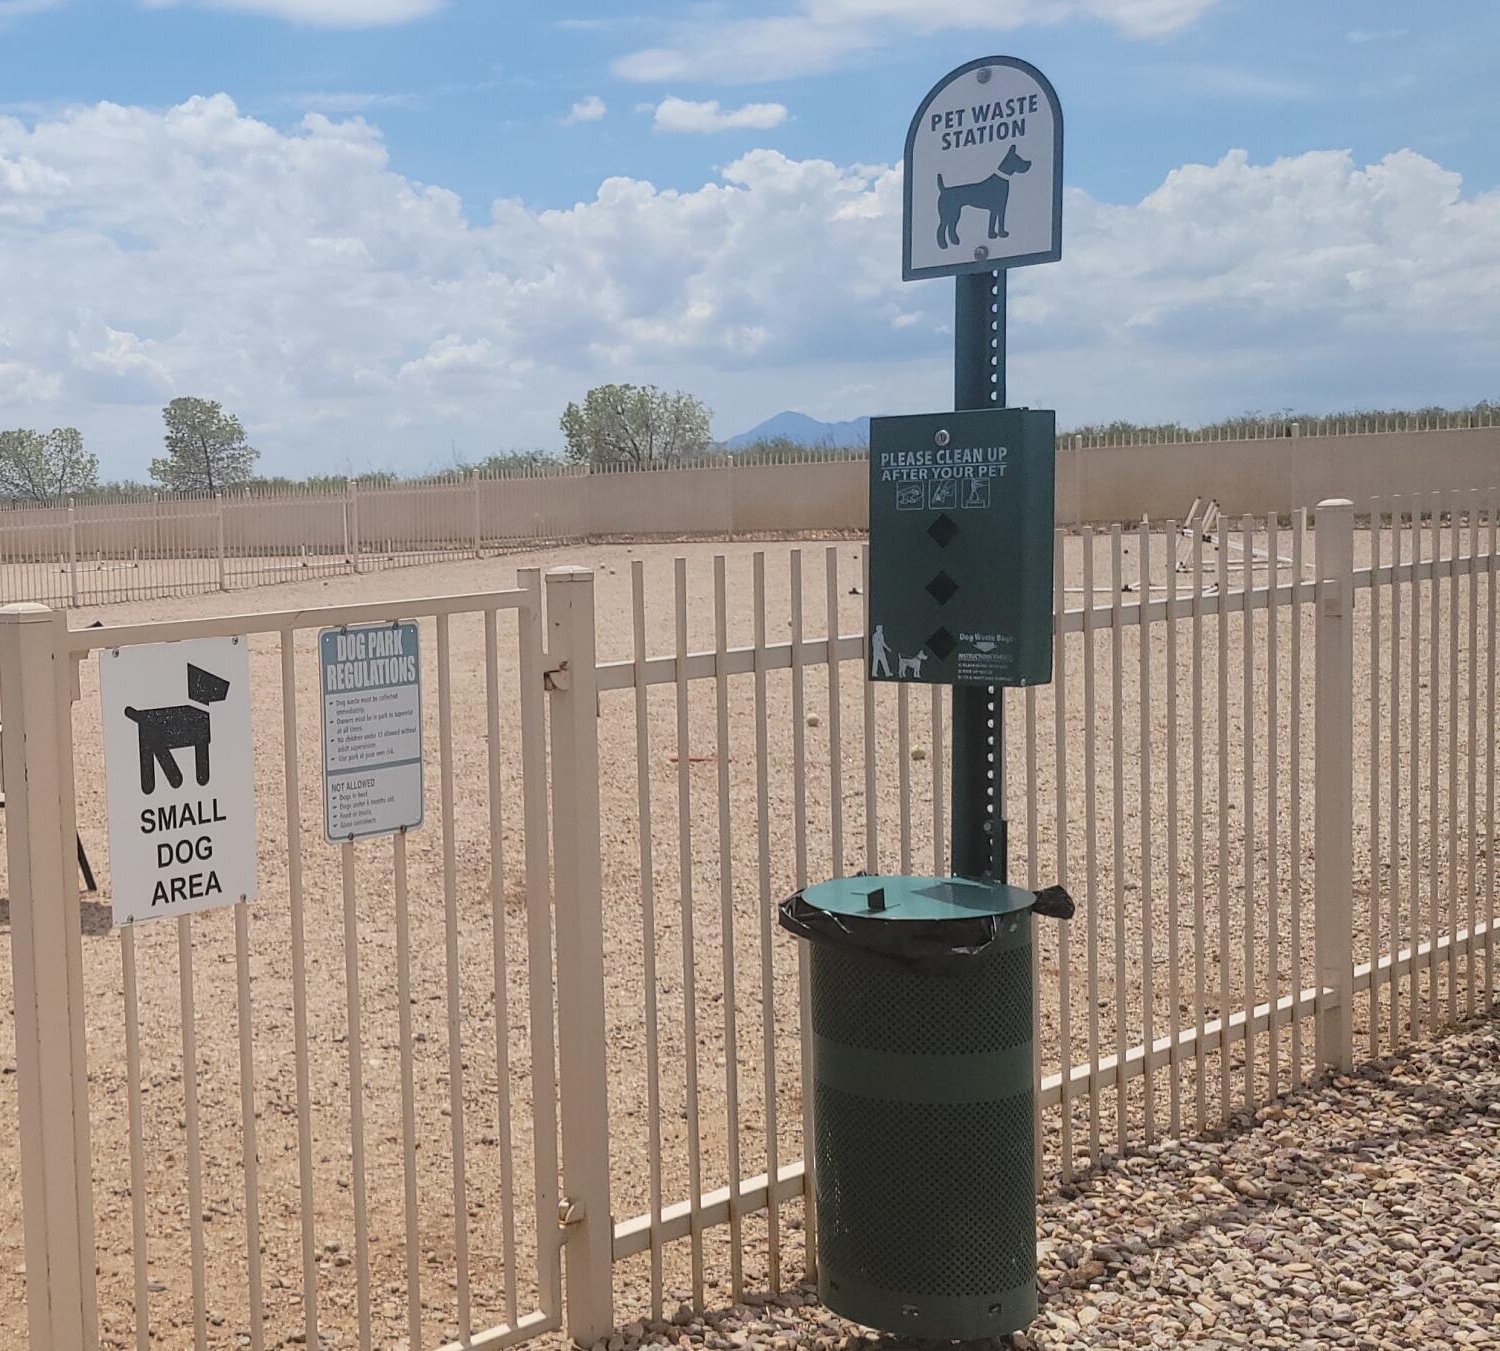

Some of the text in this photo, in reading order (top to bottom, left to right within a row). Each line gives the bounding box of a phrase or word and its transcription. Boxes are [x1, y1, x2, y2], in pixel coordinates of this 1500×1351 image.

[931, 94, 1038, 132] PET WASTE
[941, 118, 1026, 151] STATION
[881, 447, 1007, 467] PLEASE CLEAN UP
[881, 464, 1007, 482] AFTER YOUR PET
[337, 629, 403, 661] DOG PARK
[959, 633, 974, 643] Dog
[327, 655, 415, 691] REGULATIONS
[331, 778, 376, 793] NOT ALLOWED
[140, 798, 227, 834] SMALL
[157, 836, 213, 868] DOG
[151, 870, 222, 907] AREA
